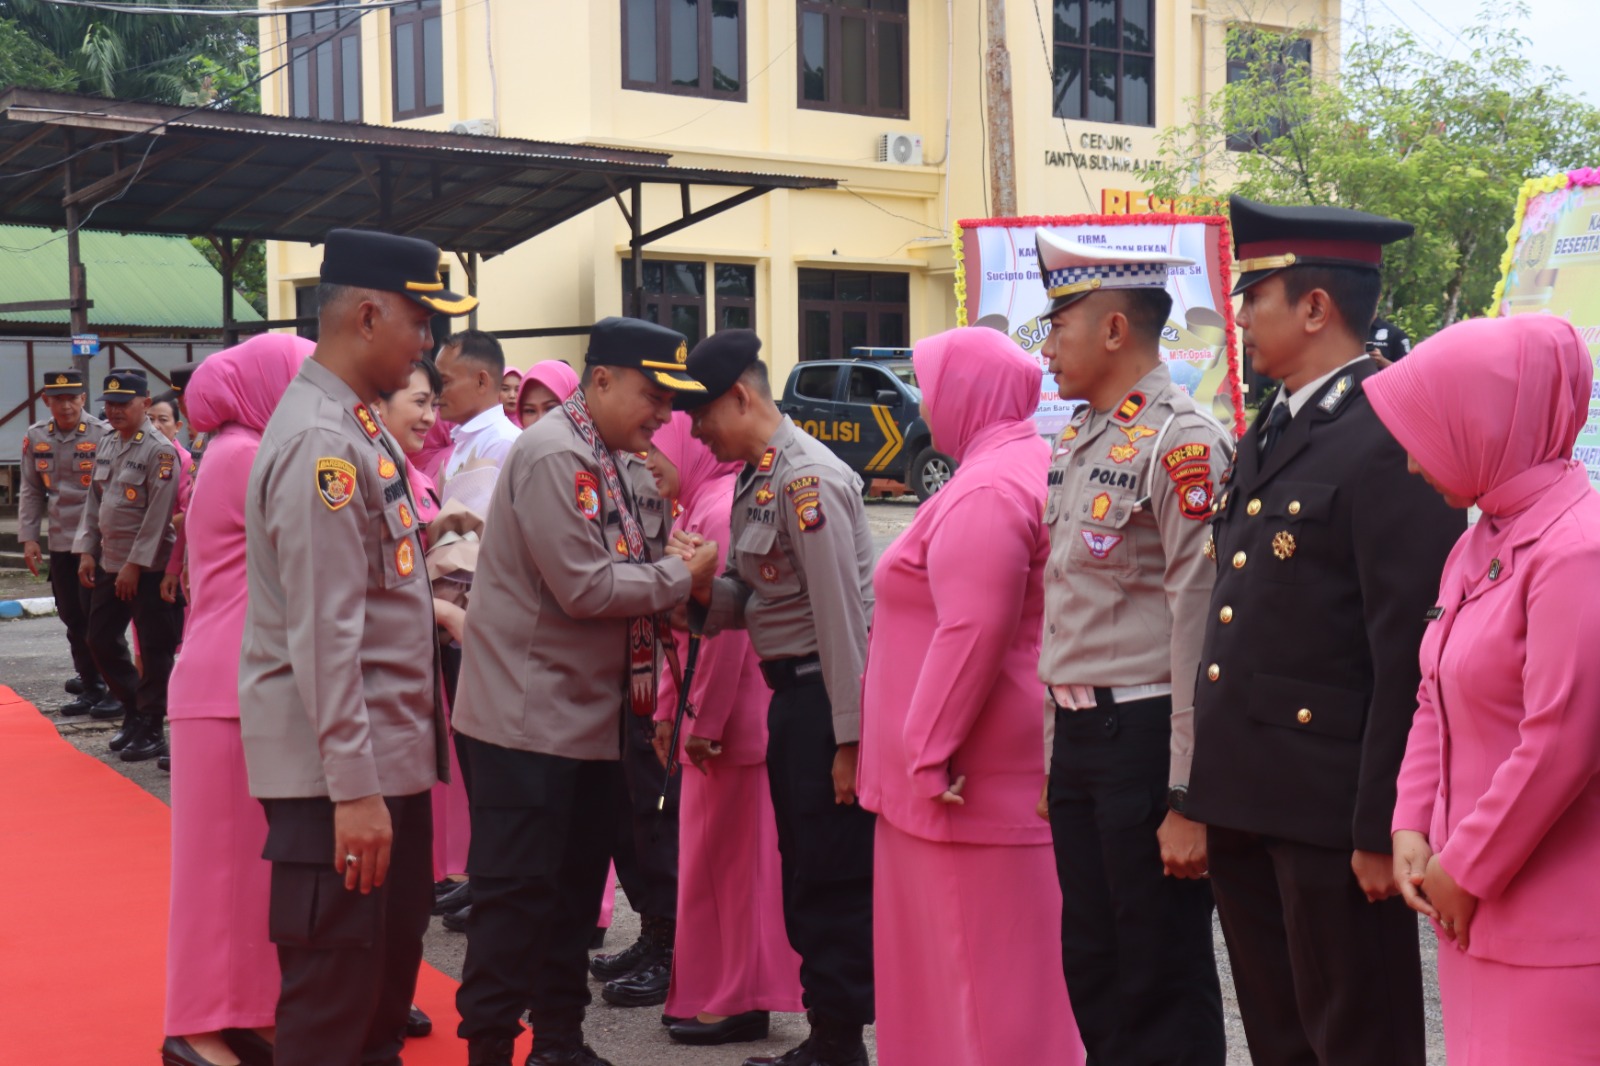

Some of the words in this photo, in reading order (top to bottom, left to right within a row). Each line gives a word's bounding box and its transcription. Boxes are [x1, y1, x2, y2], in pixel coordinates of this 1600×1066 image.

[1077, 235, 1107, 244] FIRMA
[1018, 248, 1037, 257] KAN
[987, 271, 1024, 282] Sucipto
[1041, 391, 1062, 401] MUH
[1053, 404, 1070, 412] Baru
[1089, 467, 1136, 490] POLRI
[747, 506, 776, 524] POLRI
